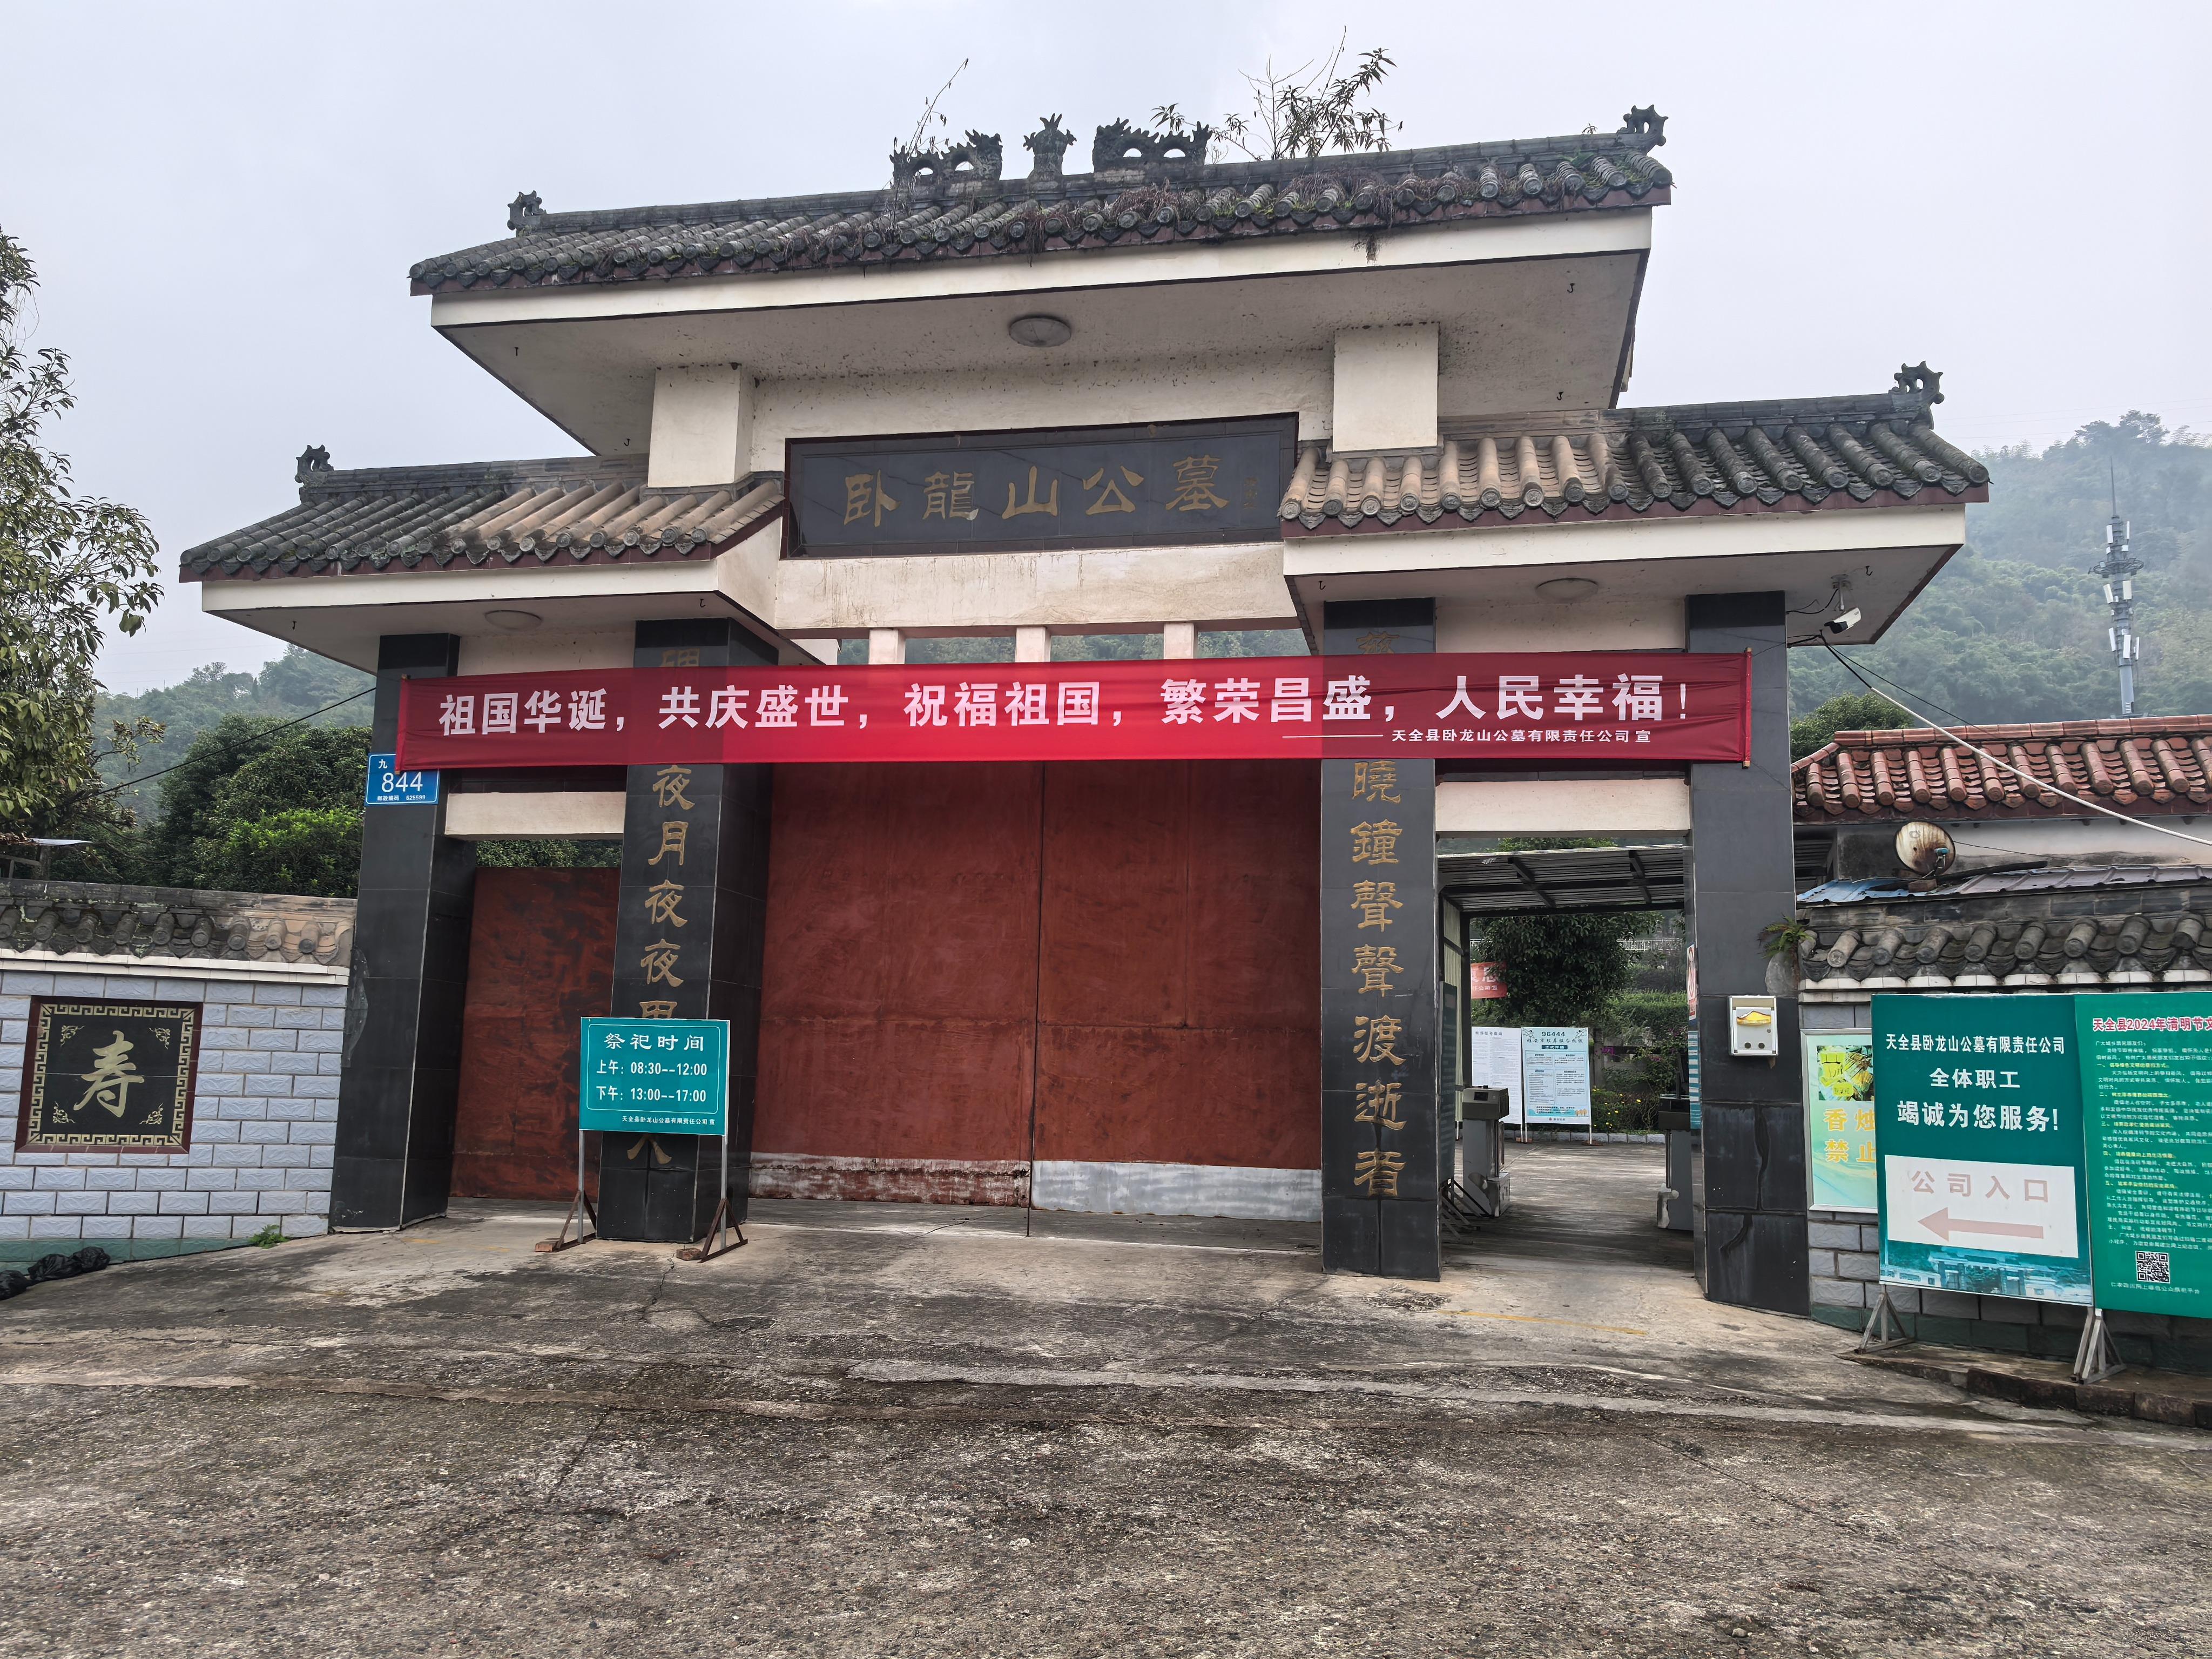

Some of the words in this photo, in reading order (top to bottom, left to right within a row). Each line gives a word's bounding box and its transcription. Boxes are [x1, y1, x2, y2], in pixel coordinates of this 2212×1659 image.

[381, 772, 423, 793] 844
[604, 1033, 704, 1051] 祭祀时间
[1886, 1034, 2065, 1054] 天全县卧龙山公墓有限责任公司
[73, 1030, 145, 1118] 寿
[1930, 1068, 2020, 1089] 全体职工
[1911, 1170, 2048, 1203] 公司入口
